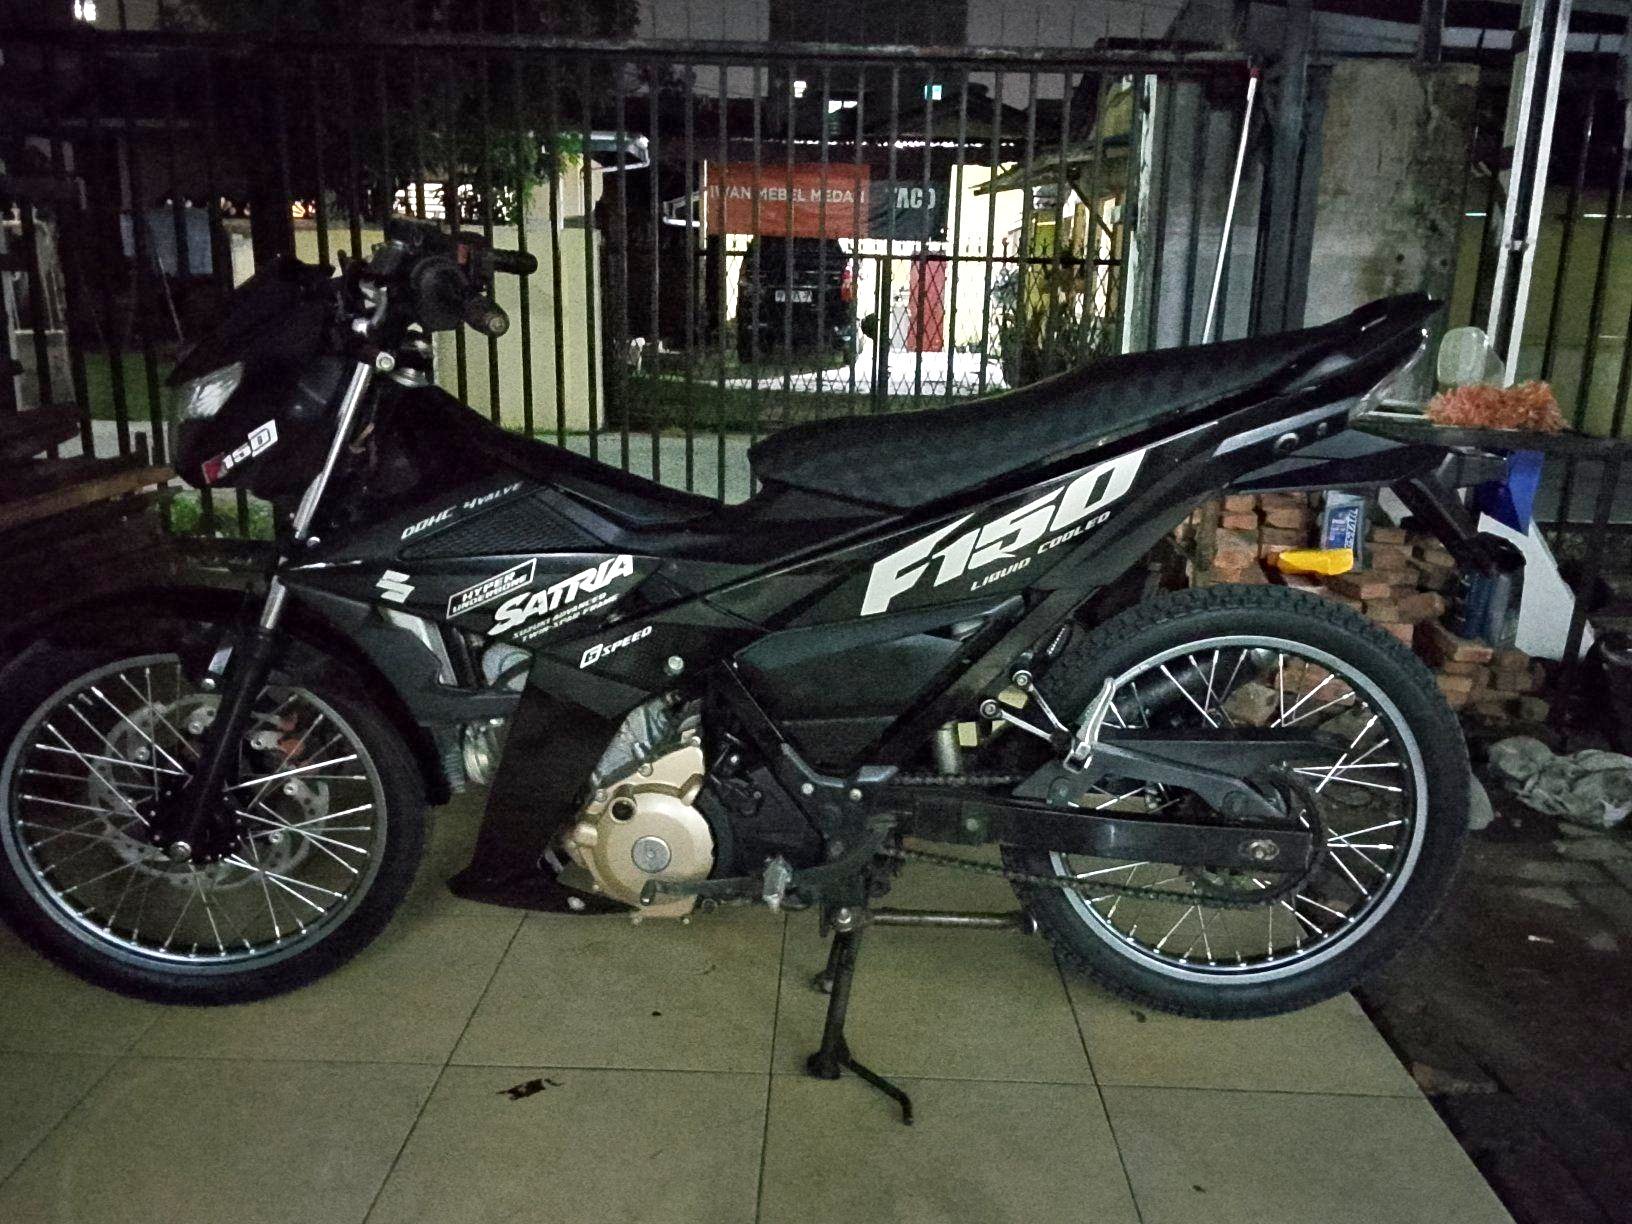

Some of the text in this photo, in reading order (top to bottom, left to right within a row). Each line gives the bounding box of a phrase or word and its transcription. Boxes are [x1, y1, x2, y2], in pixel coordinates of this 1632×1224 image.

[759, 187, 806, 202] MEBEL
[860, 449, 1146, 616] F150
[970, 510, 1111, 592] LIQUID COOLED
[462, 571, 516, 602] HYPER
[487, 554, 635, 636] SATRIA
